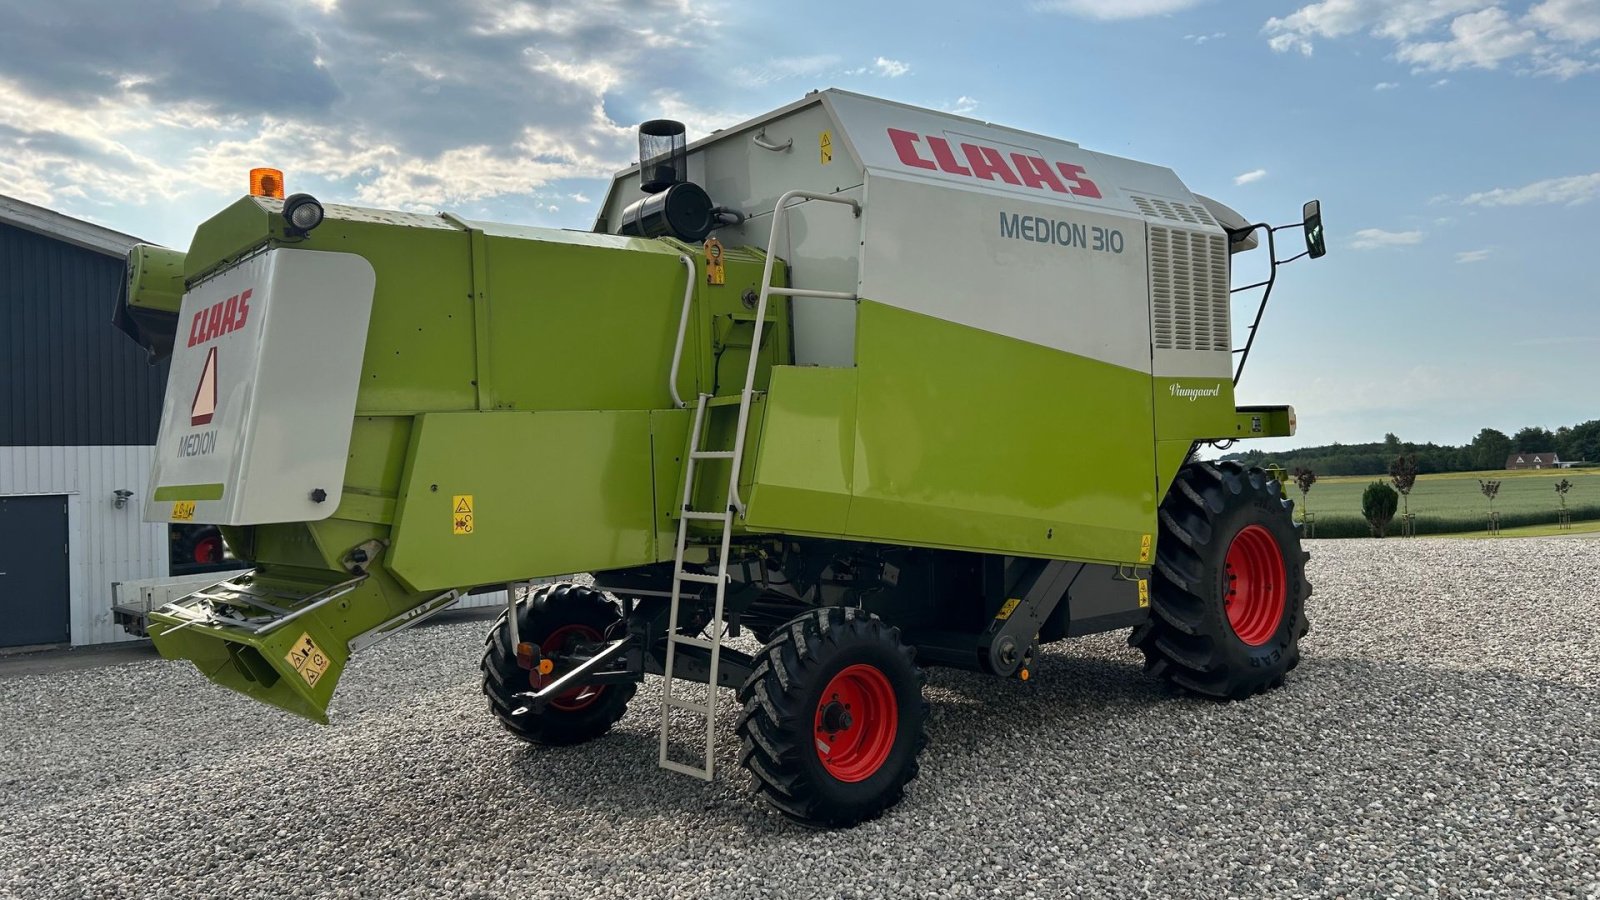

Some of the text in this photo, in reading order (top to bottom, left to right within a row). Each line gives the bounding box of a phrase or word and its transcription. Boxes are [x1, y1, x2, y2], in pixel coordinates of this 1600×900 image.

[887, 127, 1103, 200] CLAAS
[999, 211, 1124, 254] MEDION 310
[187, 288, 253, 348] CLAAS
[177, 430, 218, 458] MEDION
